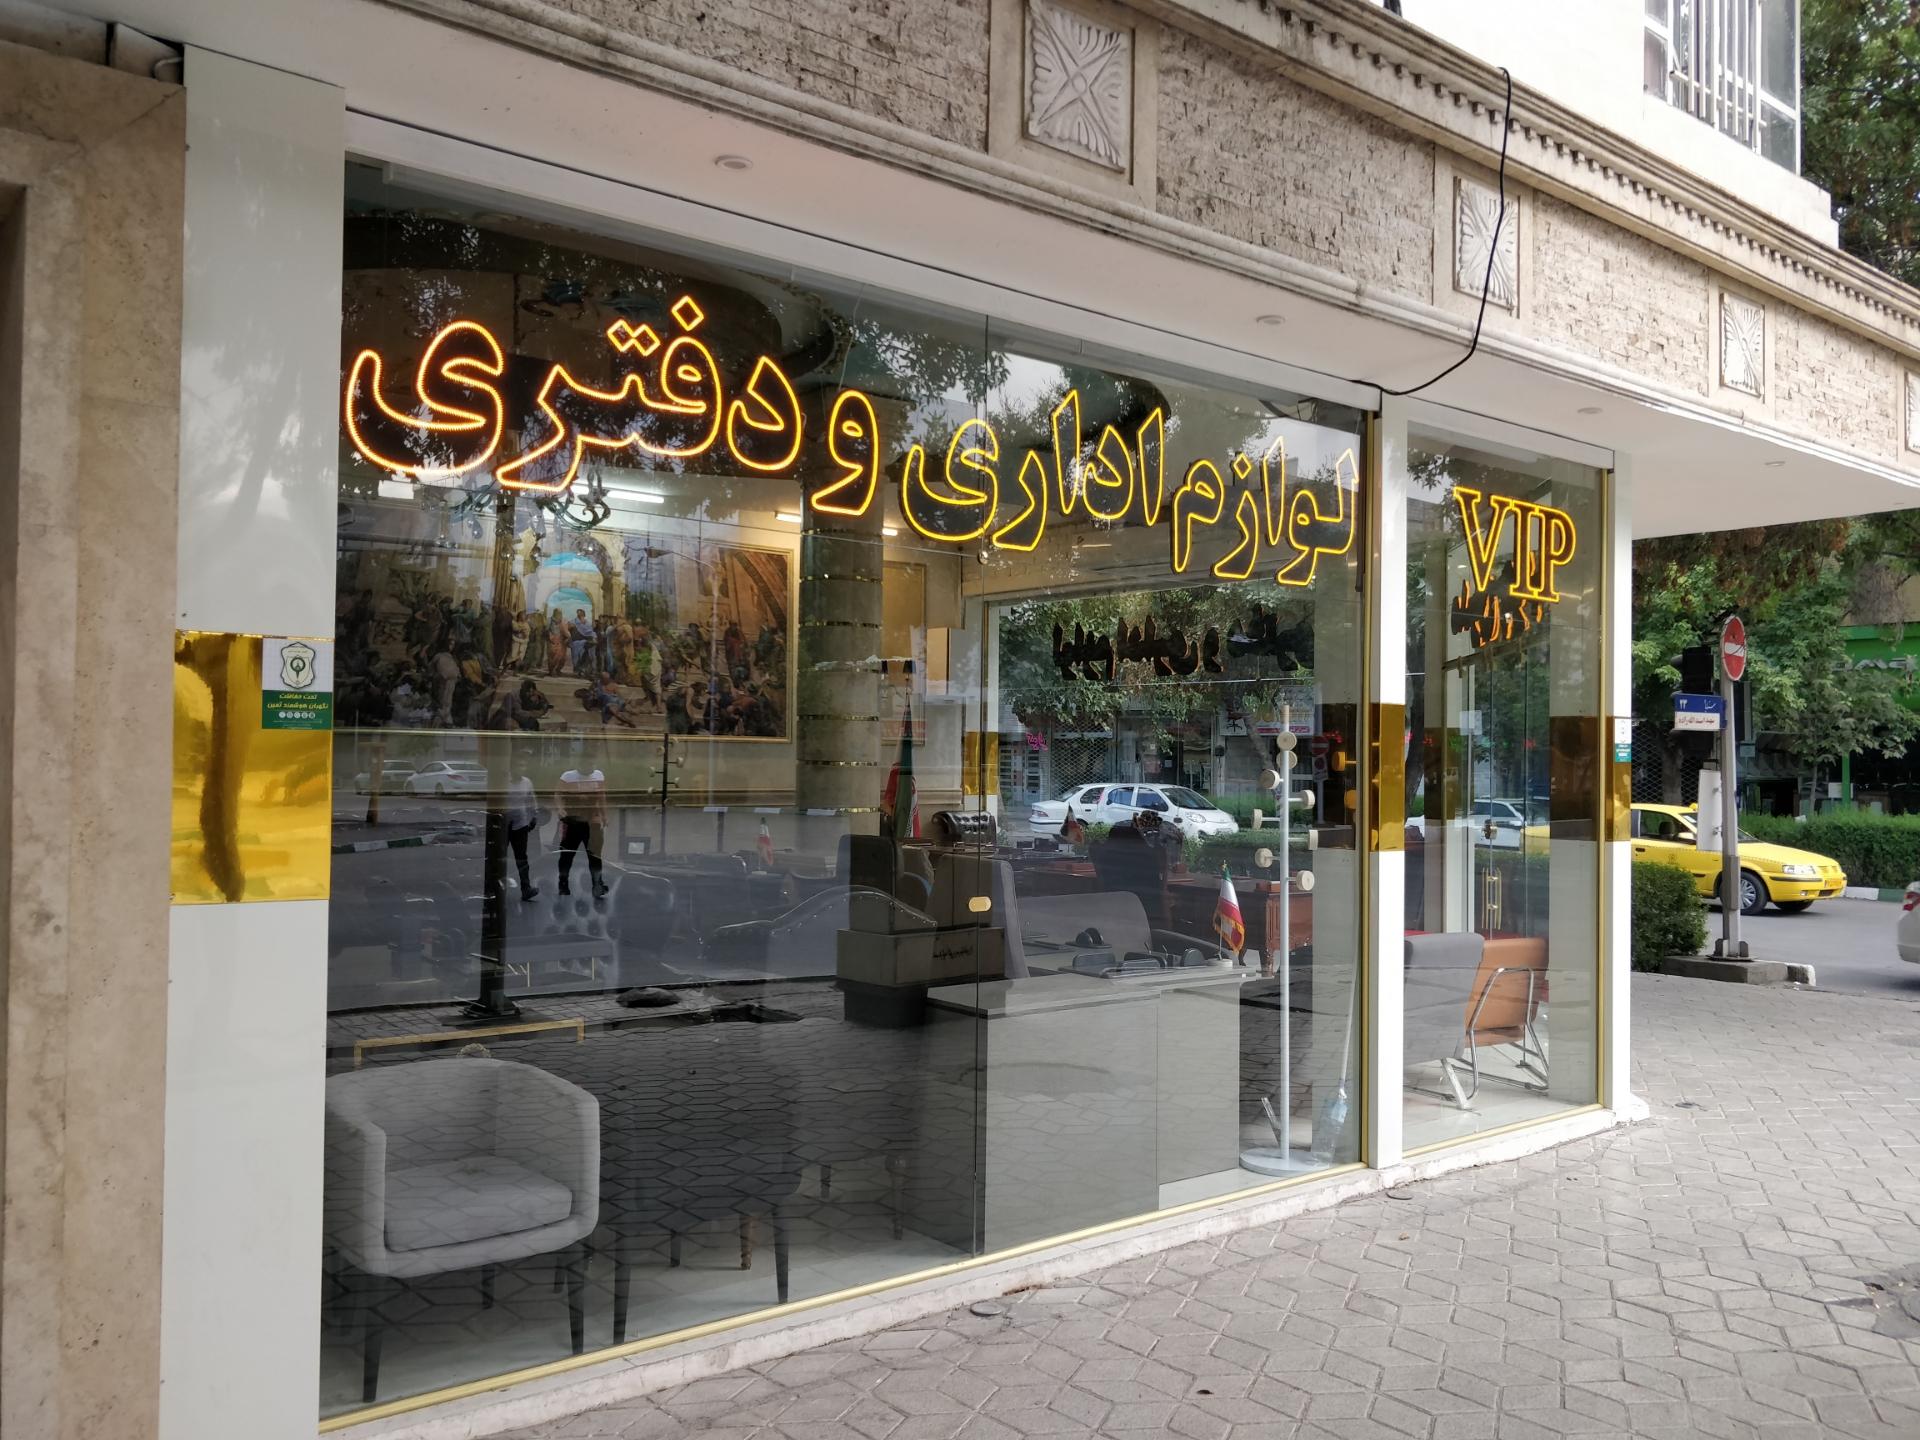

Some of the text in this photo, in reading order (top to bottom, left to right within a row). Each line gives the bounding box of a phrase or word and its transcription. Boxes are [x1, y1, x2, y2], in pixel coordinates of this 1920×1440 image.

[346, 295, 1360, 586] لوازم اداری و دفتری
[1452, 485, 1577, 603] VIP
